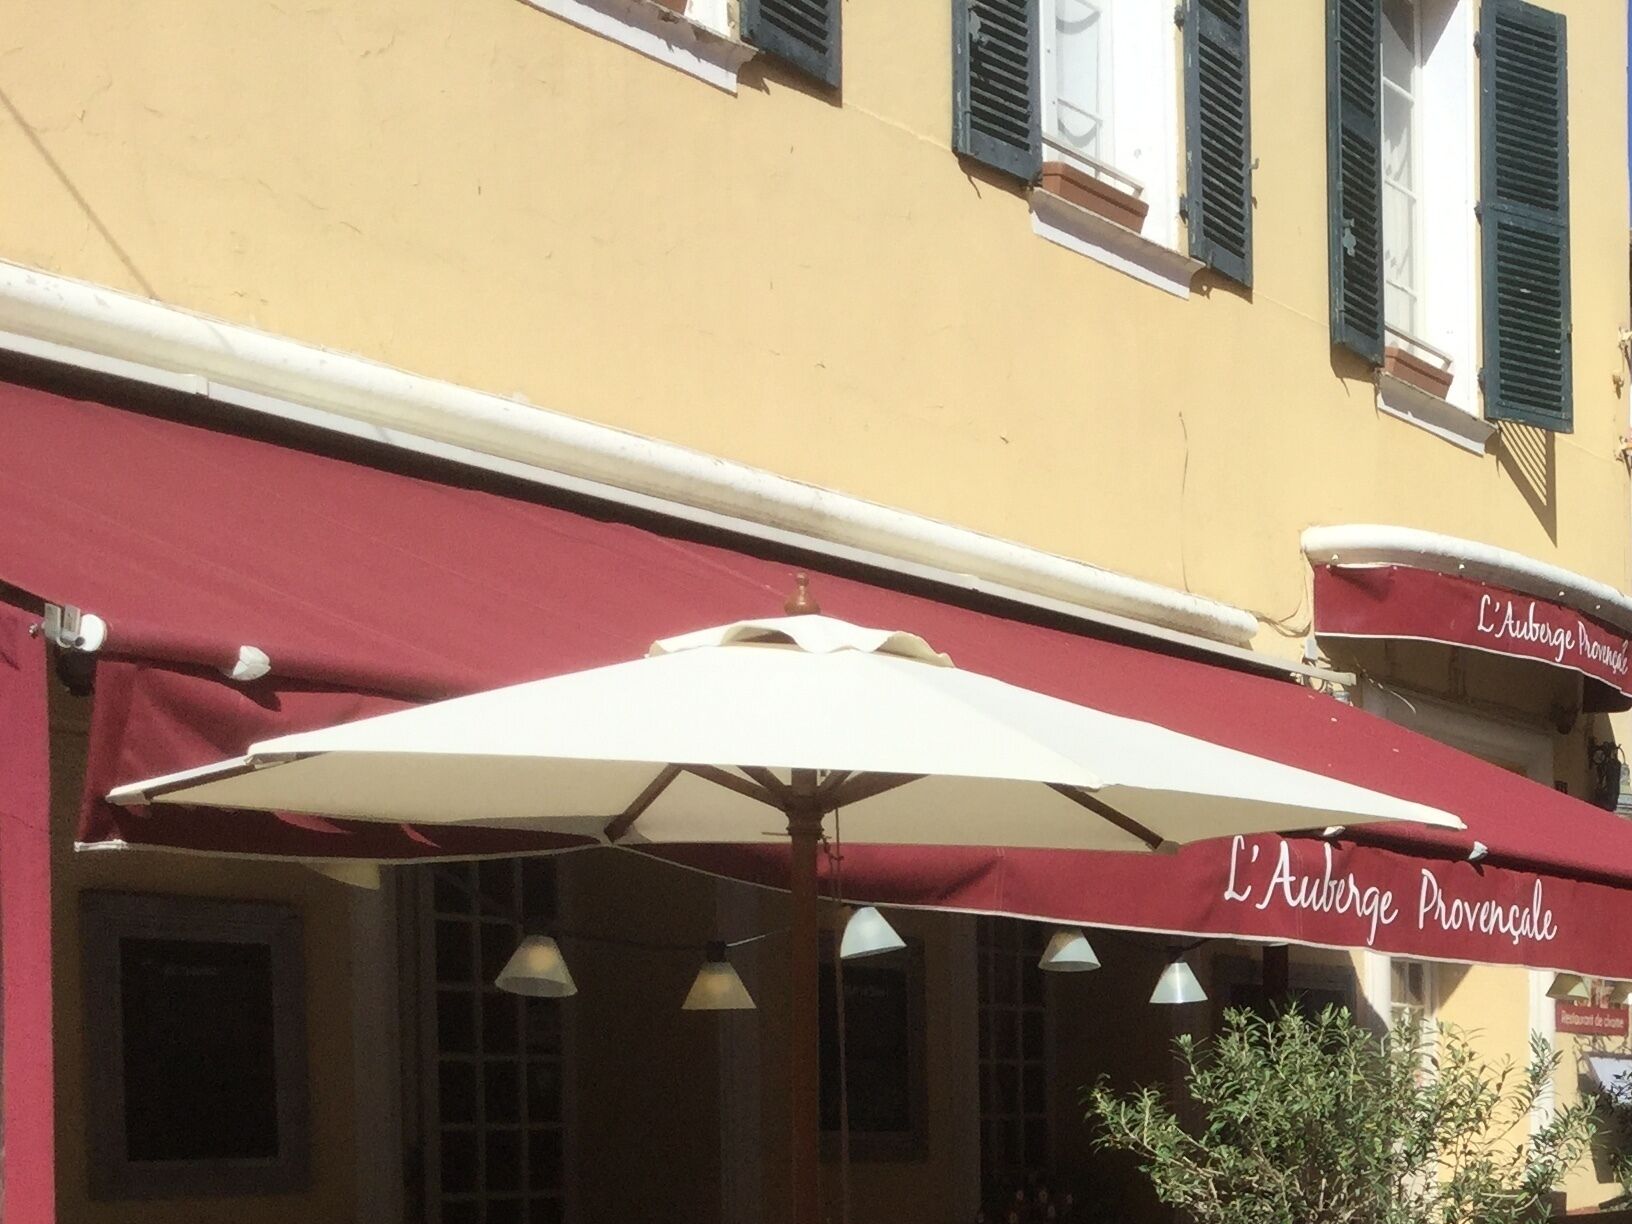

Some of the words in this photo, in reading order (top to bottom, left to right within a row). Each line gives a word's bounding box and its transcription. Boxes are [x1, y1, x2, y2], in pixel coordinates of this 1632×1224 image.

[1477, 594, 1576, 662] L'Auberge
[1223, 834, 1399, 946] L'Auberge
[1418, 868, 1558, 945] Provençale
